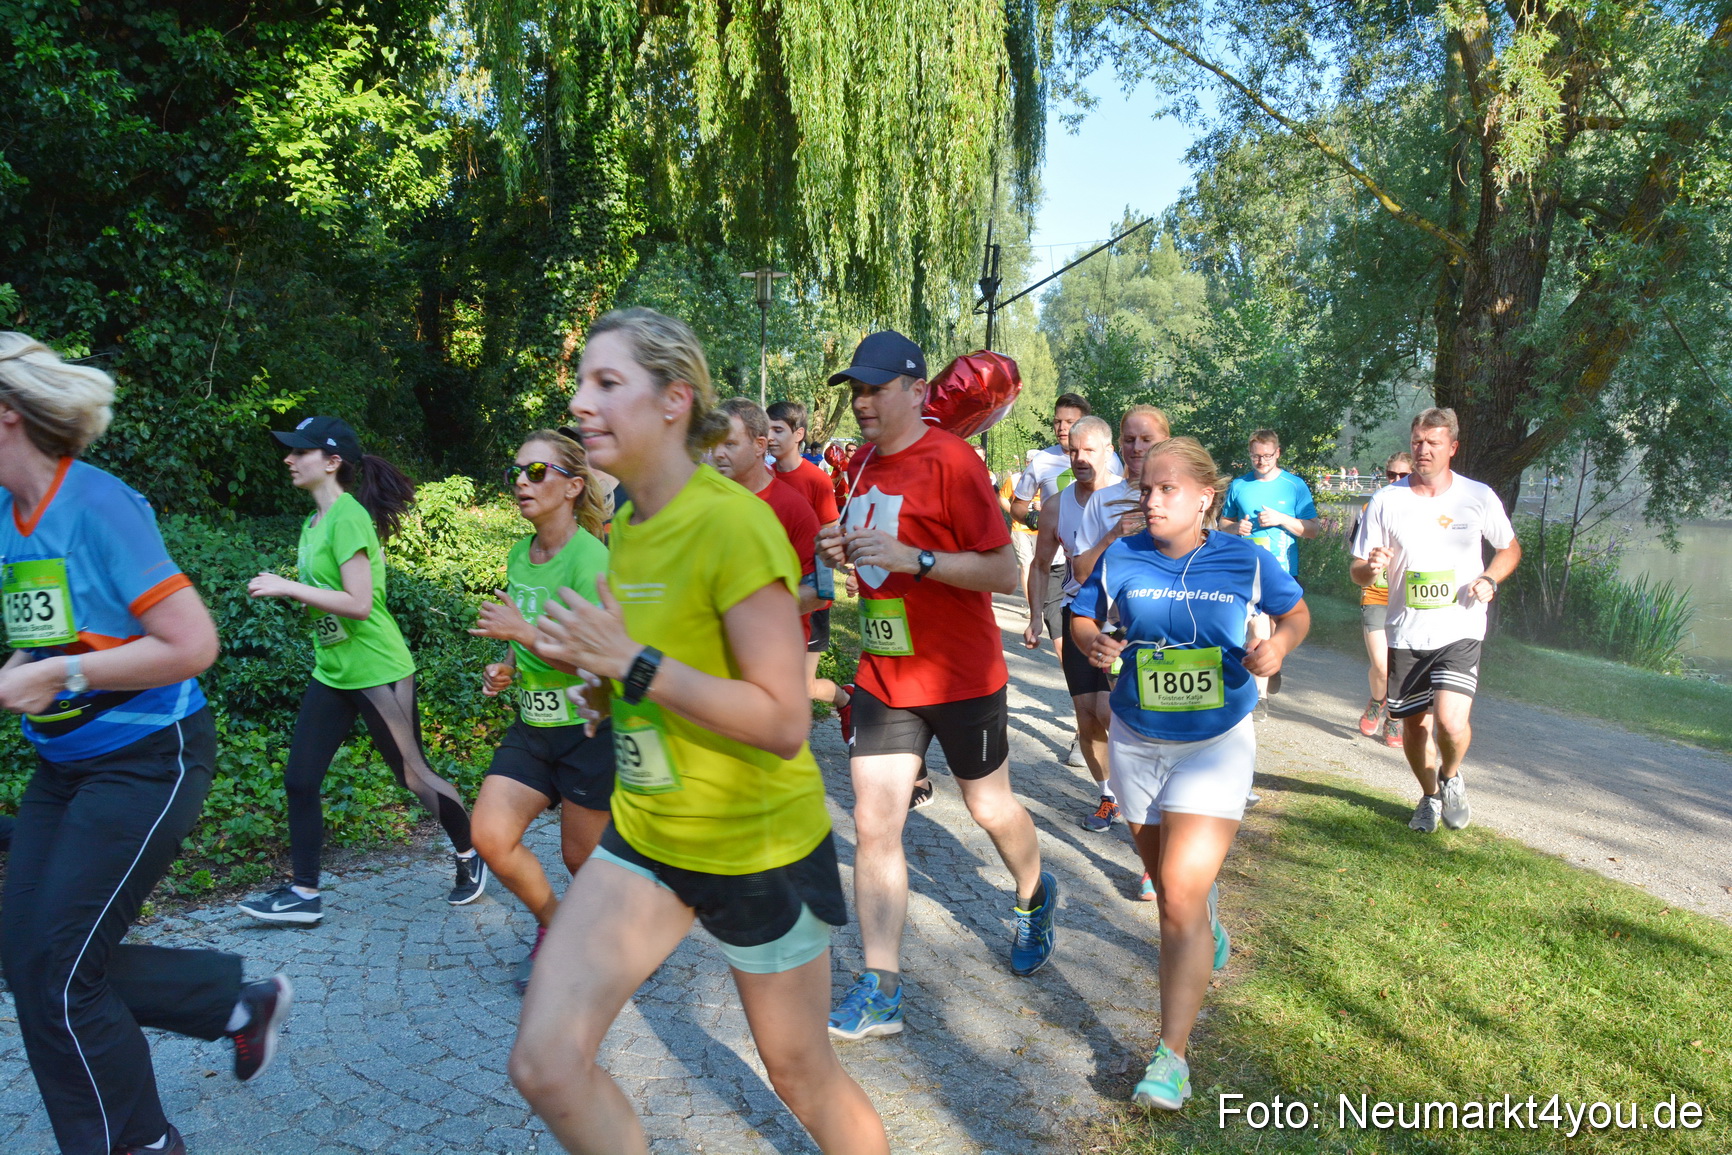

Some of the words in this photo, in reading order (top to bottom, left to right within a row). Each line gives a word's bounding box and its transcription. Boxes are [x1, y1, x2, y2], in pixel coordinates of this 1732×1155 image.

[1126, 586, 1235, 604] energiegeladen
[1411, 583, 1450, 599] 1000
[7, 591, 54, 623] 1583
[865, 618, 893, 640] 419
[1148, 671, 1212, 694] 1805
